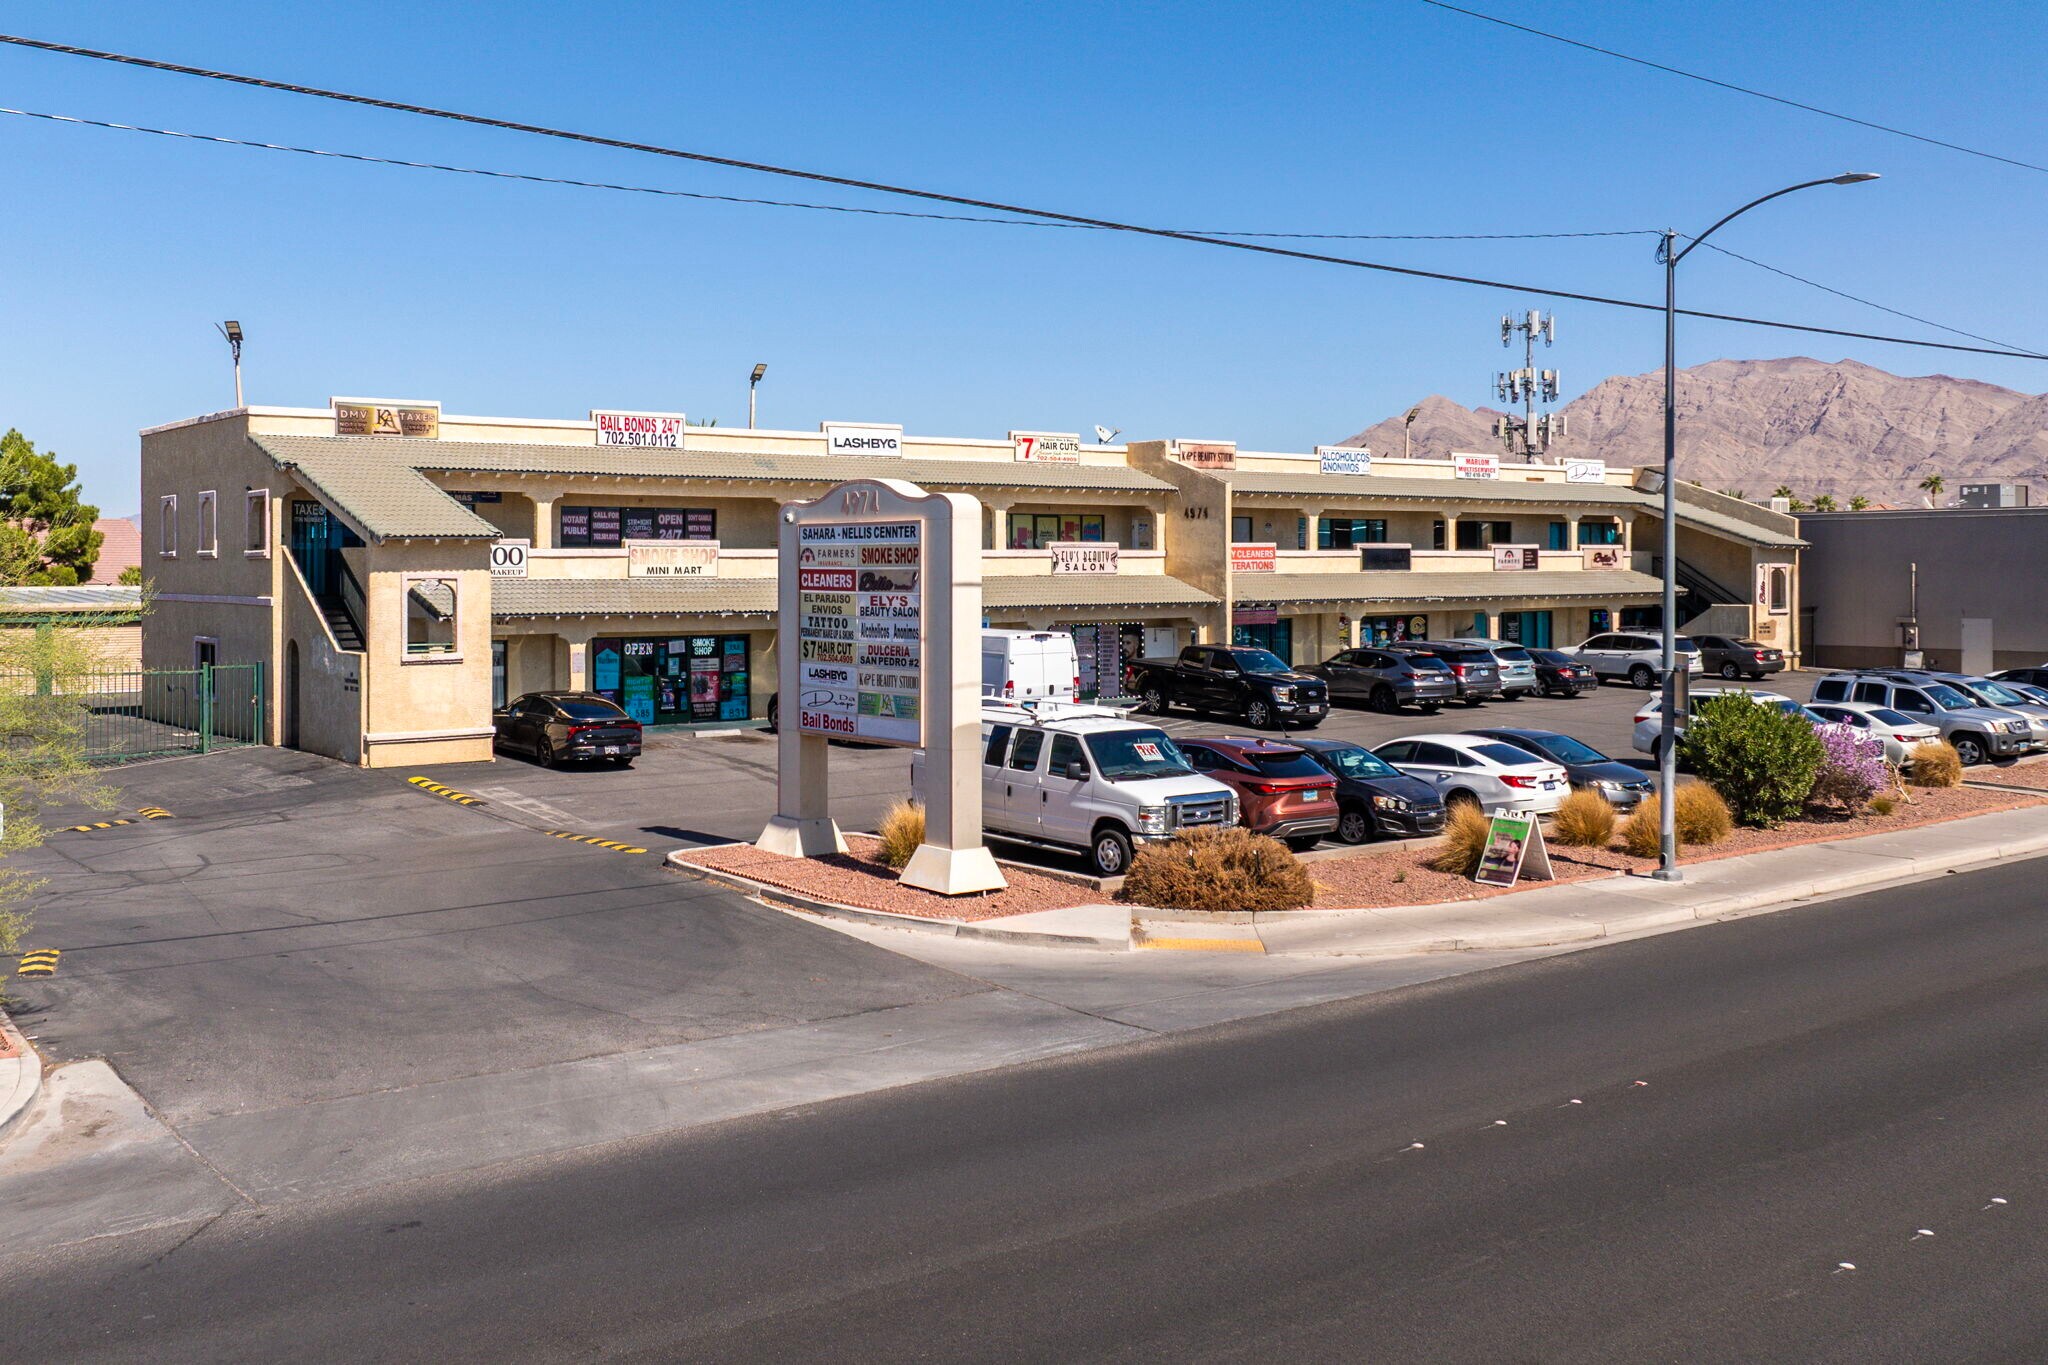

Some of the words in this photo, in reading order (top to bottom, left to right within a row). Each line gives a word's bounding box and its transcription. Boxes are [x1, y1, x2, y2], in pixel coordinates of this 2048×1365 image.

[340, 409, 368, 419] DMV
[400, 412, 436, 422] TAXES
[600, 415, 622, 431] BAIL
[624, 417, 657, 433] BONDS
[605, 431, 677, 447] 702.501.0112
[834, 437, 897, 449] LASHBYG
[1040, 442, 1058, 450] HAIR
[1060, 443, 1079, 451] CUTS
[1198, 451, 1216, 462] BEAUTY
[1322, 451, 1370, 462] ALCOHOLICOS
[1323, 462, 1360, 472] ANONIMOS
[840, 490, 880, 515] 4974
[294, 503, 325, 516] TAXES
[1184, 507, 1209, 519] 4974
[562, 515, 588, 524] NOTARY
[658, 514, 683, 525] OPEN
[563, 526, 588, 535] PUBLIC
[659, 529, 683, 540] 24/7
[802, 527, 836, 540] SAHARA
[842, 526, 872, 539] NELLIS
[874, 525, 917, 538] CENNTER
[631, 548, 678, 565] SMOKE
[682, 548, 717, 565] SHOP
[817, 549, 855, 558] FARMERS
[861, 547, 893, 564] SMOKE
[894, 547, 919, 564] SHOP
[1083, 550, 1110, 563] BEAUTY
[1236, 550, 1274, 558] CLEANERS
[646, 566, 669, 575] MINI
[674, 566, 702, 575] MART
[1065, 563, 1105, 571] SALON
[1231, 561, 1274, 570] TERATIONS
[801, 573, 852, 588] CLEANERS
[804, 594, 814, 603] EL
[815, 594, 851, 604] PARAISO
[870, 595, 908, 607] ELY'S
[812, 605, 843, 615] ENVIOS
[860, 607, 891, 617] BEAUTY
[892, 607, 919, 618] SALON
[808, 616, 848, 629] TATTOO
[692, 638, 715, 647] SMOKE
[817, 641, 836, 654] HAIR
[836, 642, 852, 655] CUT
[624, 642, 654, 655] OPEN
[694, 647, 713, 655] SHOP
[868, 645, 910, 657] DULCERIA
[860, 656, 877, 665] SAN
[879, 657, 907, 667] PEDRO
[908, 658, 920, 667] #2
[808, 668, 848, 680] LASHBYG
[876, 675, 898, 688] BEAUTY
[899, 675, 919, 689] STUDIO
[802, 711, 821, 726] Bail
[822, 713, 854, 733] Bonds
